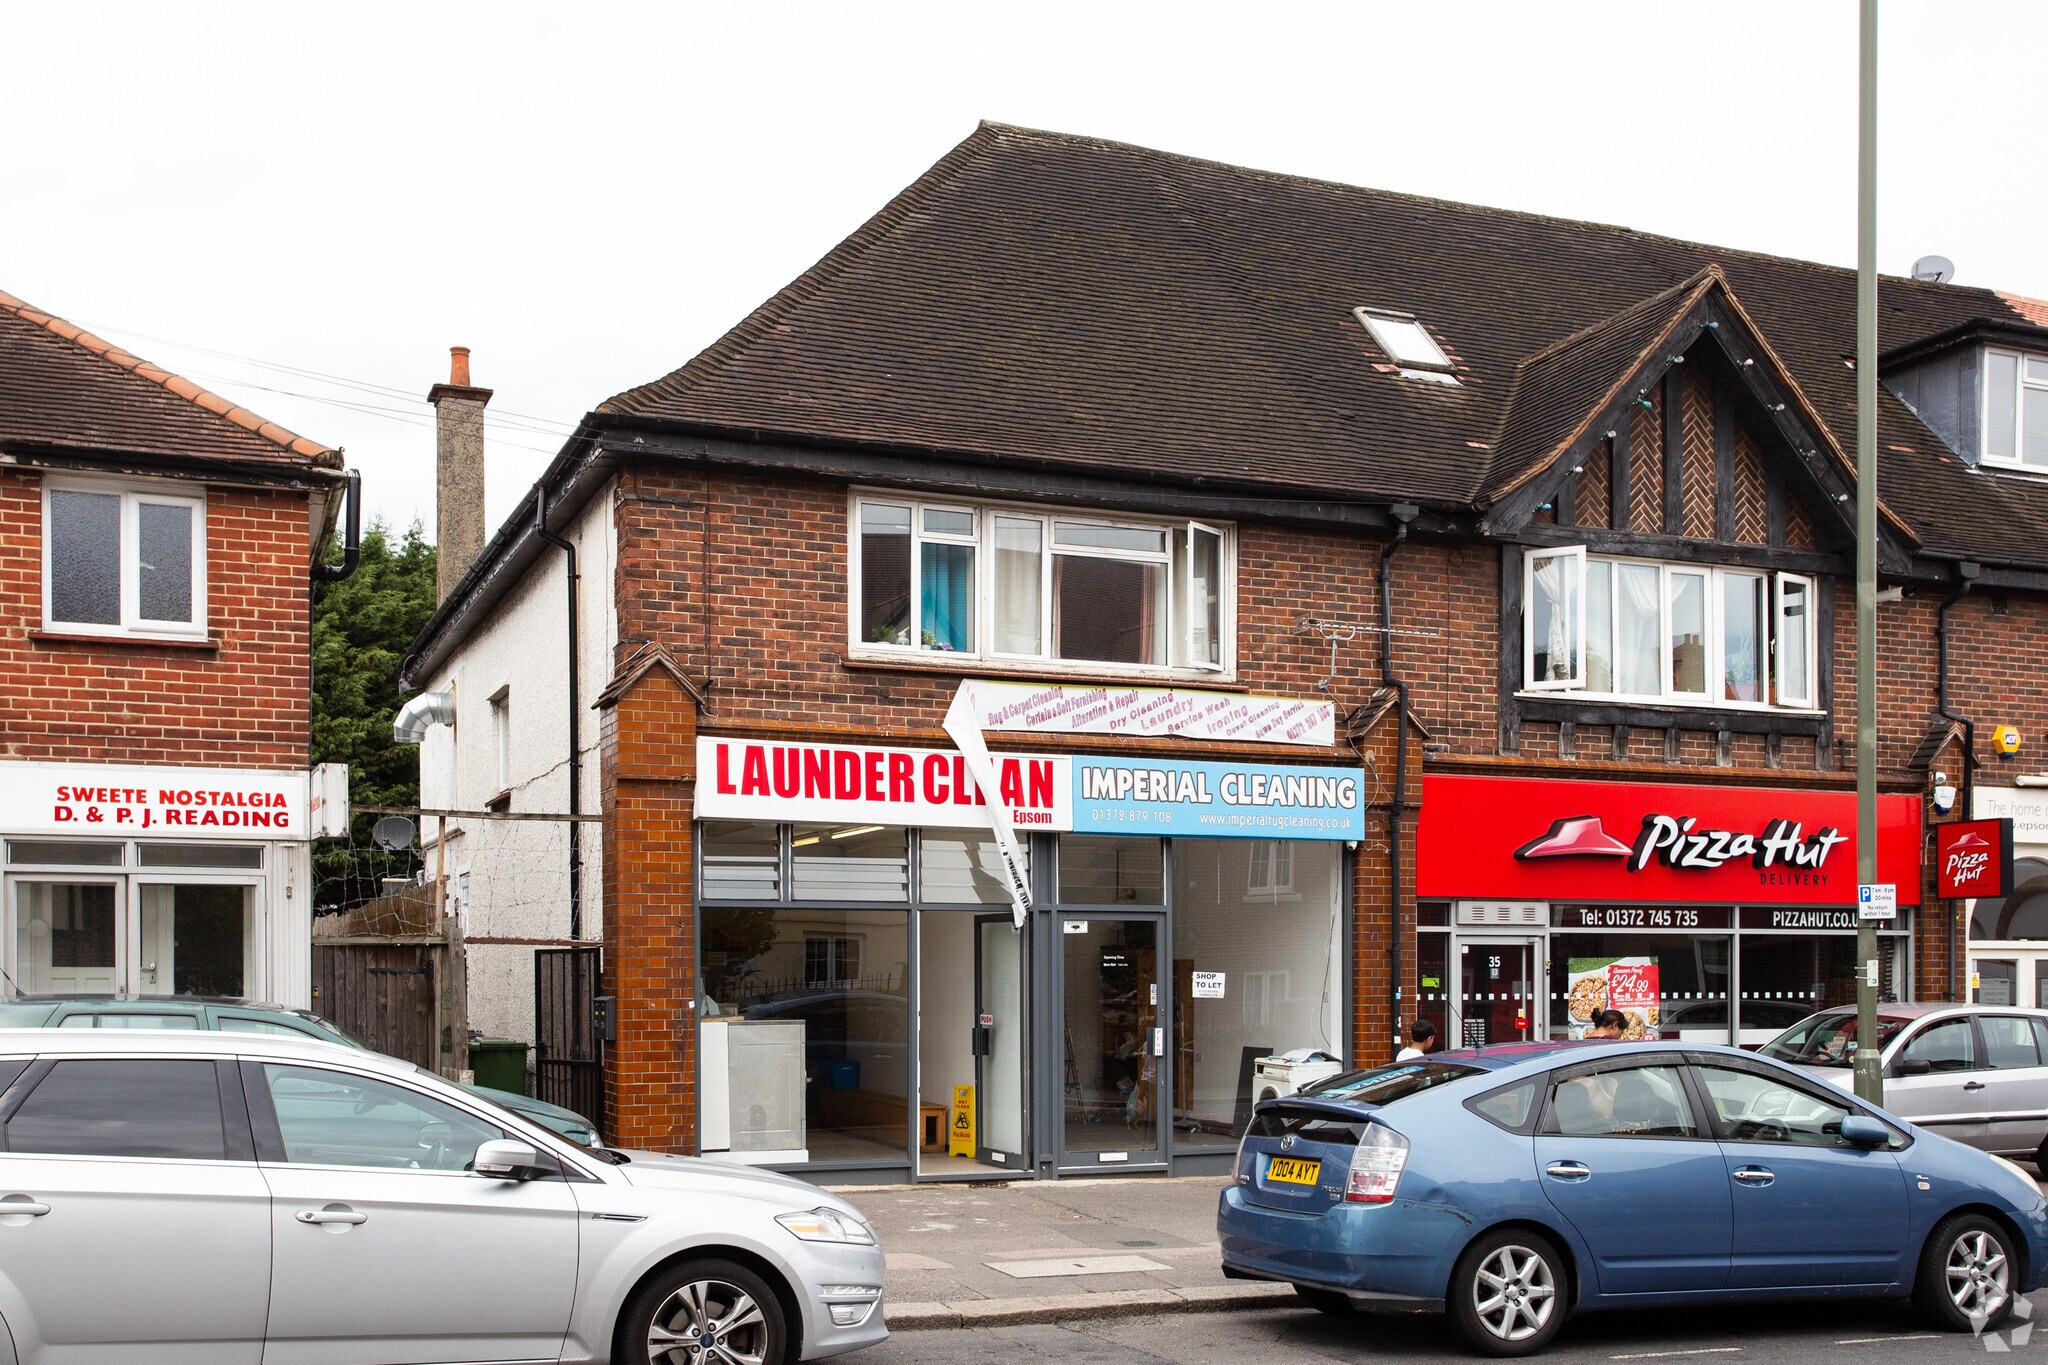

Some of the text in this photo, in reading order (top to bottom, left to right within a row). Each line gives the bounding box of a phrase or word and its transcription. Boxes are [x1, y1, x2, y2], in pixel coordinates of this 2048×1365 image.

[987, 686, 1064, 726] Rug & Carpet Cleaning
[1026, 708, 1052, 727] Curtain
[1056, 699, 1072, 716] Soft
[1071, 688, 1107, 710] Furnishing
[1071, 689, 1139, 729] Alteration & Repair
[1109, 692, 1174, 731] Dry Cleaning
[1140, 698, 1194, 732] Laundry
[1167, 697, 1231, 734] Service Wash
[1271, 715, 1284, 729] Day
[1282, 701, 1305, 720] Service
[1207, 704, 1249, 734] Ironing
[1226, 701, 1280, 737] Duvet Cleaning
[716, 743, 915, 803] LAUNDER
[56, 786, 288, 808] SWEETE NOSTALGIA
[1082, 766, 1357, 809] IMPERIAL CLEANING
[54, 805, 289, 829] D. & P. J. READING
[1013, 809, 1053, 825] Epsom
[1092, 808, 1352, 831] 01372 879 108 www.imperialrugcleaning.co.uk
[1986, 799, 2007, 815] The
[2010, 800, 2041, 816] home
[1638, 815, 1850, 870] Pizza Hut
[1945, 850, 1989, 876] Pizza
[1760, 872, 1829, 886] DELIVERY
[1953, 864, 1987, 888] Hut
[1580, 909, 1699, 927] Tel: 01372 745 735
[1488, 956, 1501, 968] 35
[1196, 972, 1217, 980] SHOP
[1611, 974, 1649, 993] £24.99
[981, 1015, 993, 1023] PUSH
[1271, 1159, 1296, 1179] YD04
[1295, 1162, 1318, 1181] AYT
